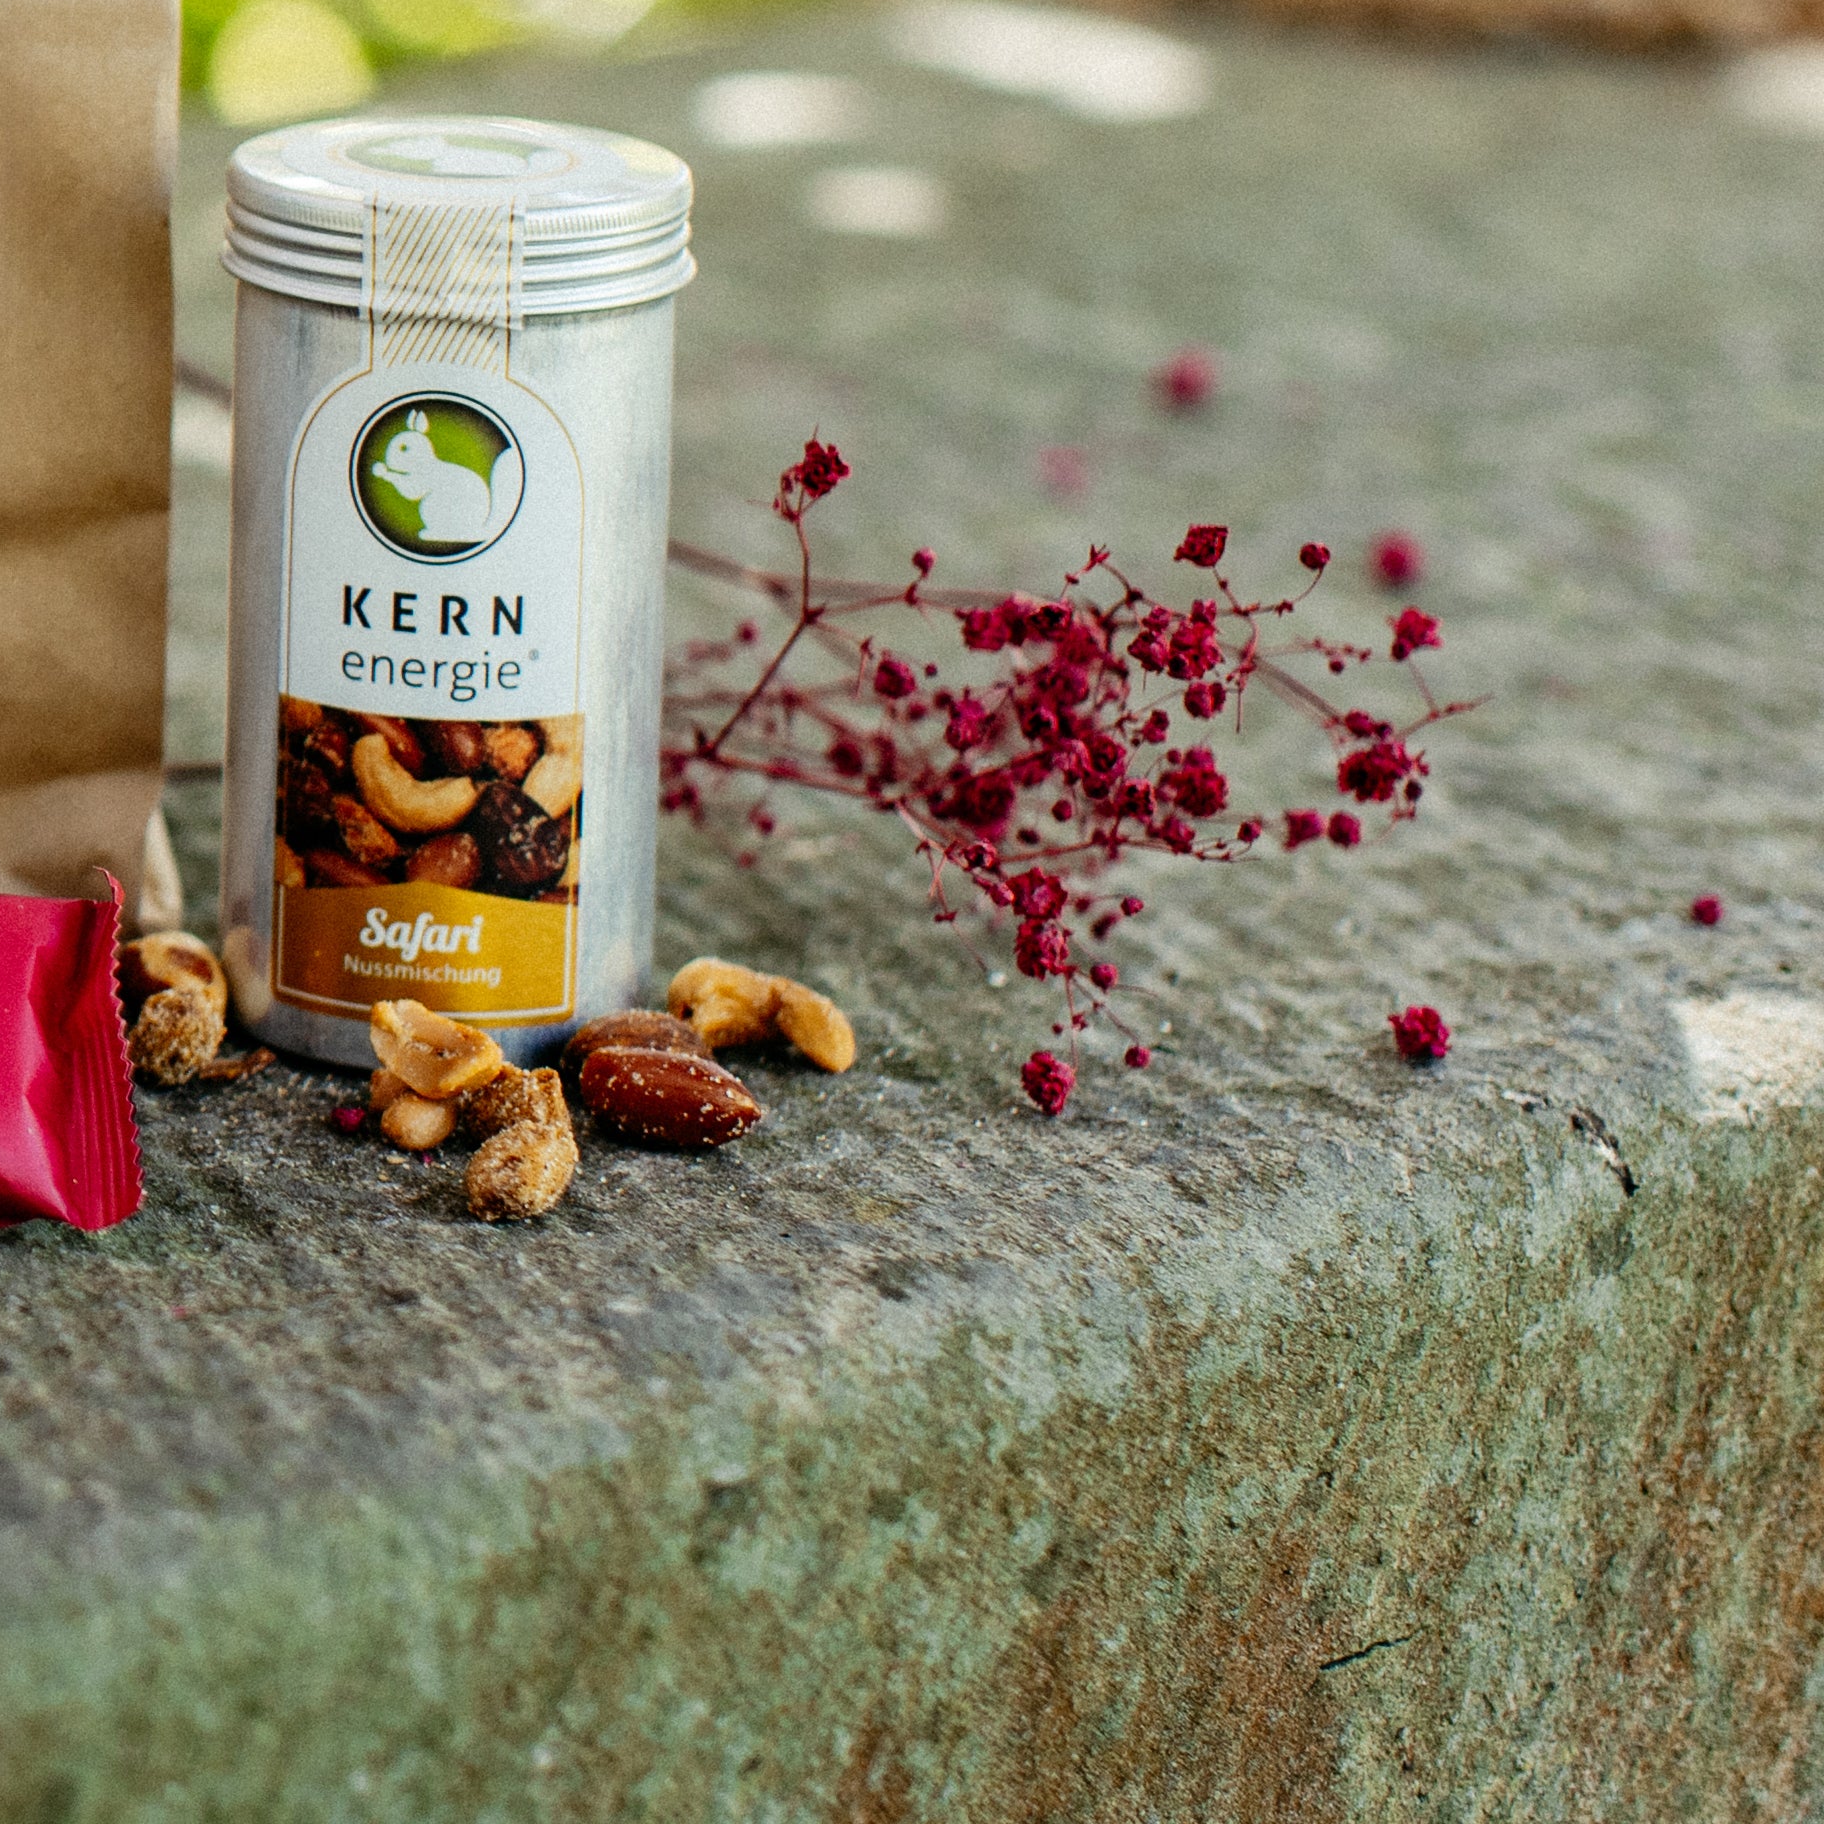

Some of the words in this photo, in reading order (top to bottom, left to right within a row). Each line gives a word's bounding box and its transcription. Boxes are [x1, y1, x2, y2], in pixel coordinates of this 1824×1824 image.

[341, 584, 525, 636] KERN
[341, 649, 523, 702] energie
[359, 906, 485, 963] Safari
[343, 952, 502, 990] Nussmischung
